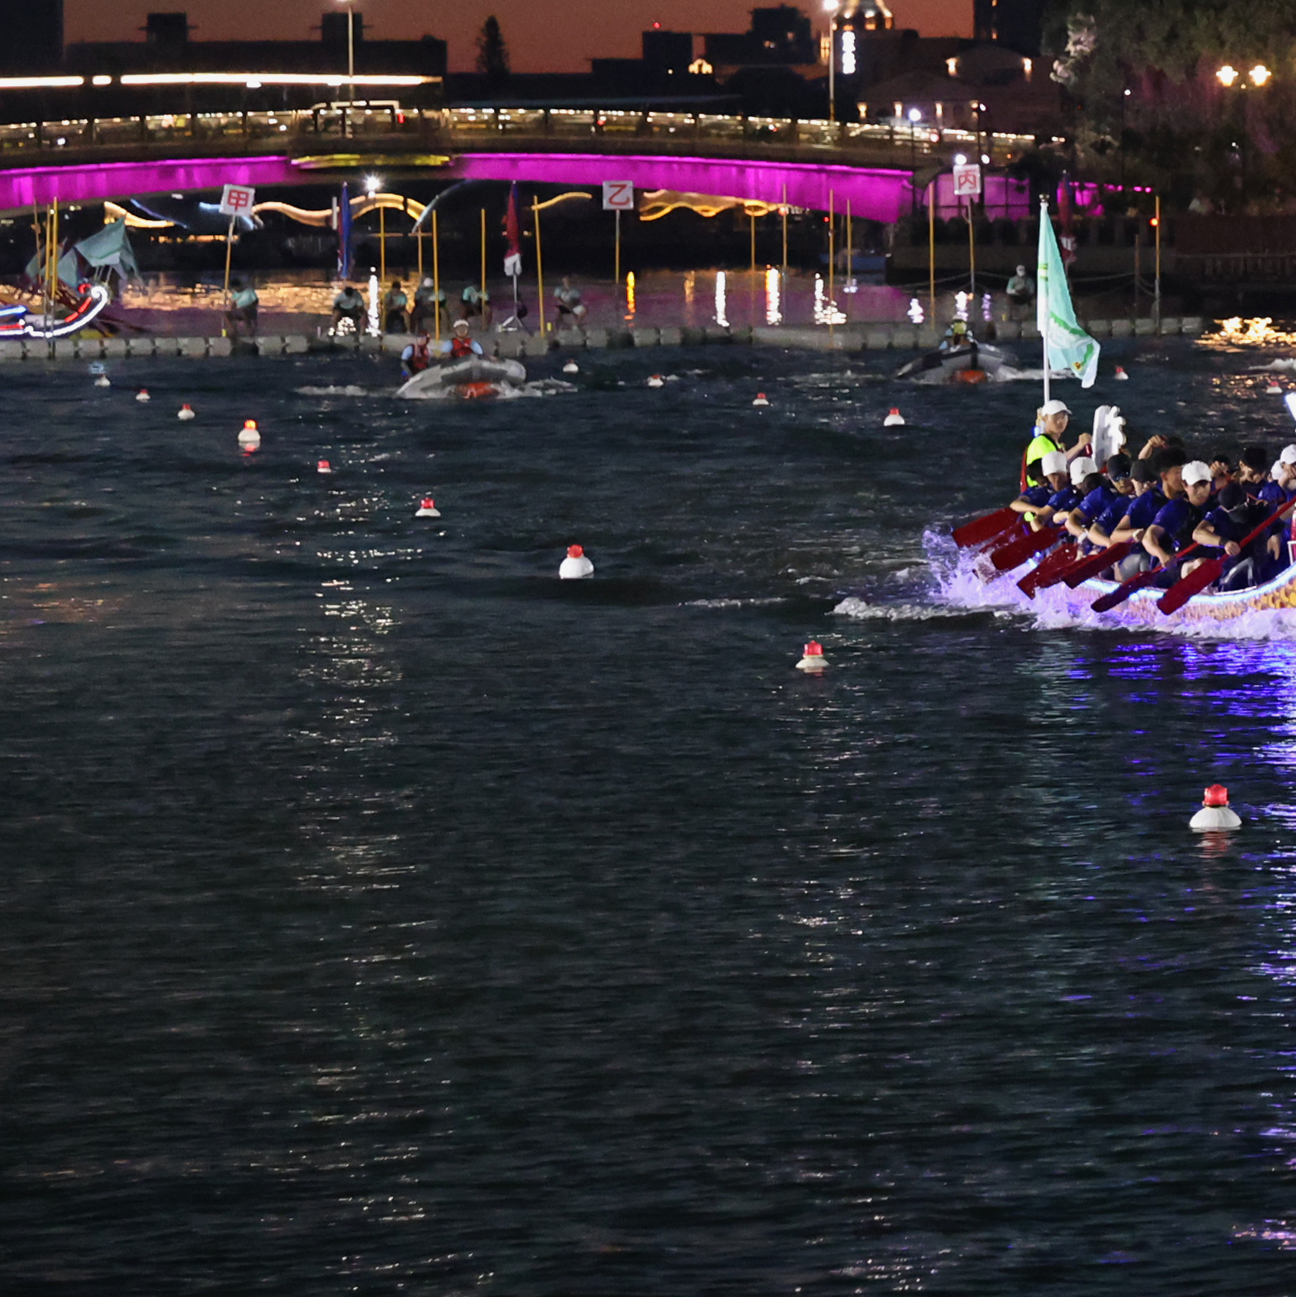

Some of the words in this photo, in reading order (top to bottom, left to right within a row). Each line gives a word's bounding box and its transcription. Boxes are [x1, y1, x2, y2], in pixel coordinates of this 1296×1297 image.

[957, 169, 977, 190] 丙
[227, 189, 250, 212] 甲
[608, 184, 630, 206] 乙
